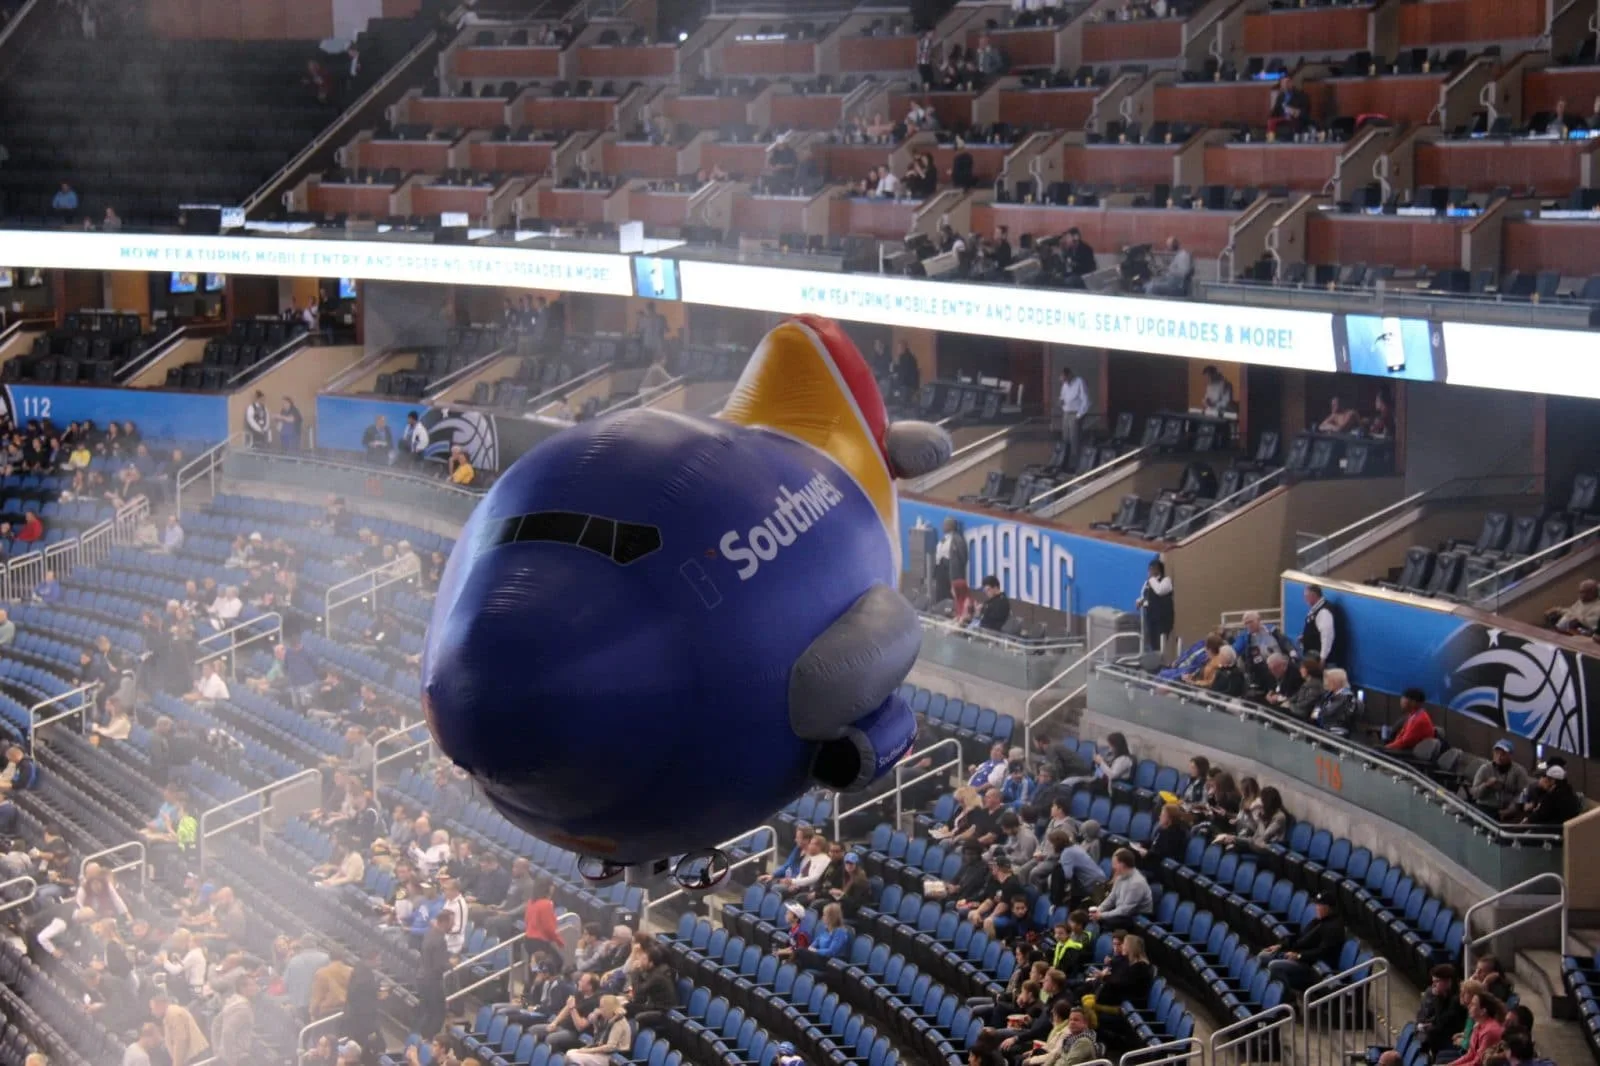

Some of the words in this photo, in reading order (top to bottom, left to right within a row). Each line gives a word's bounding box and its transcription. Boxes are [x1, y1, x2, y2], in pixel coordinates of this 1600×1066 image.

[119, 247, 159, 259] NOW
[1095, 312, 1131, 334] SEAT
[1136, 316, 1219, 343] UPGRADES
[1224, 324, 1234, 344] &
[1239, 326, 1293, 350] MORE!
[23, 396, 51, 417] 112
[1315, 755, 1343, 791] 116
